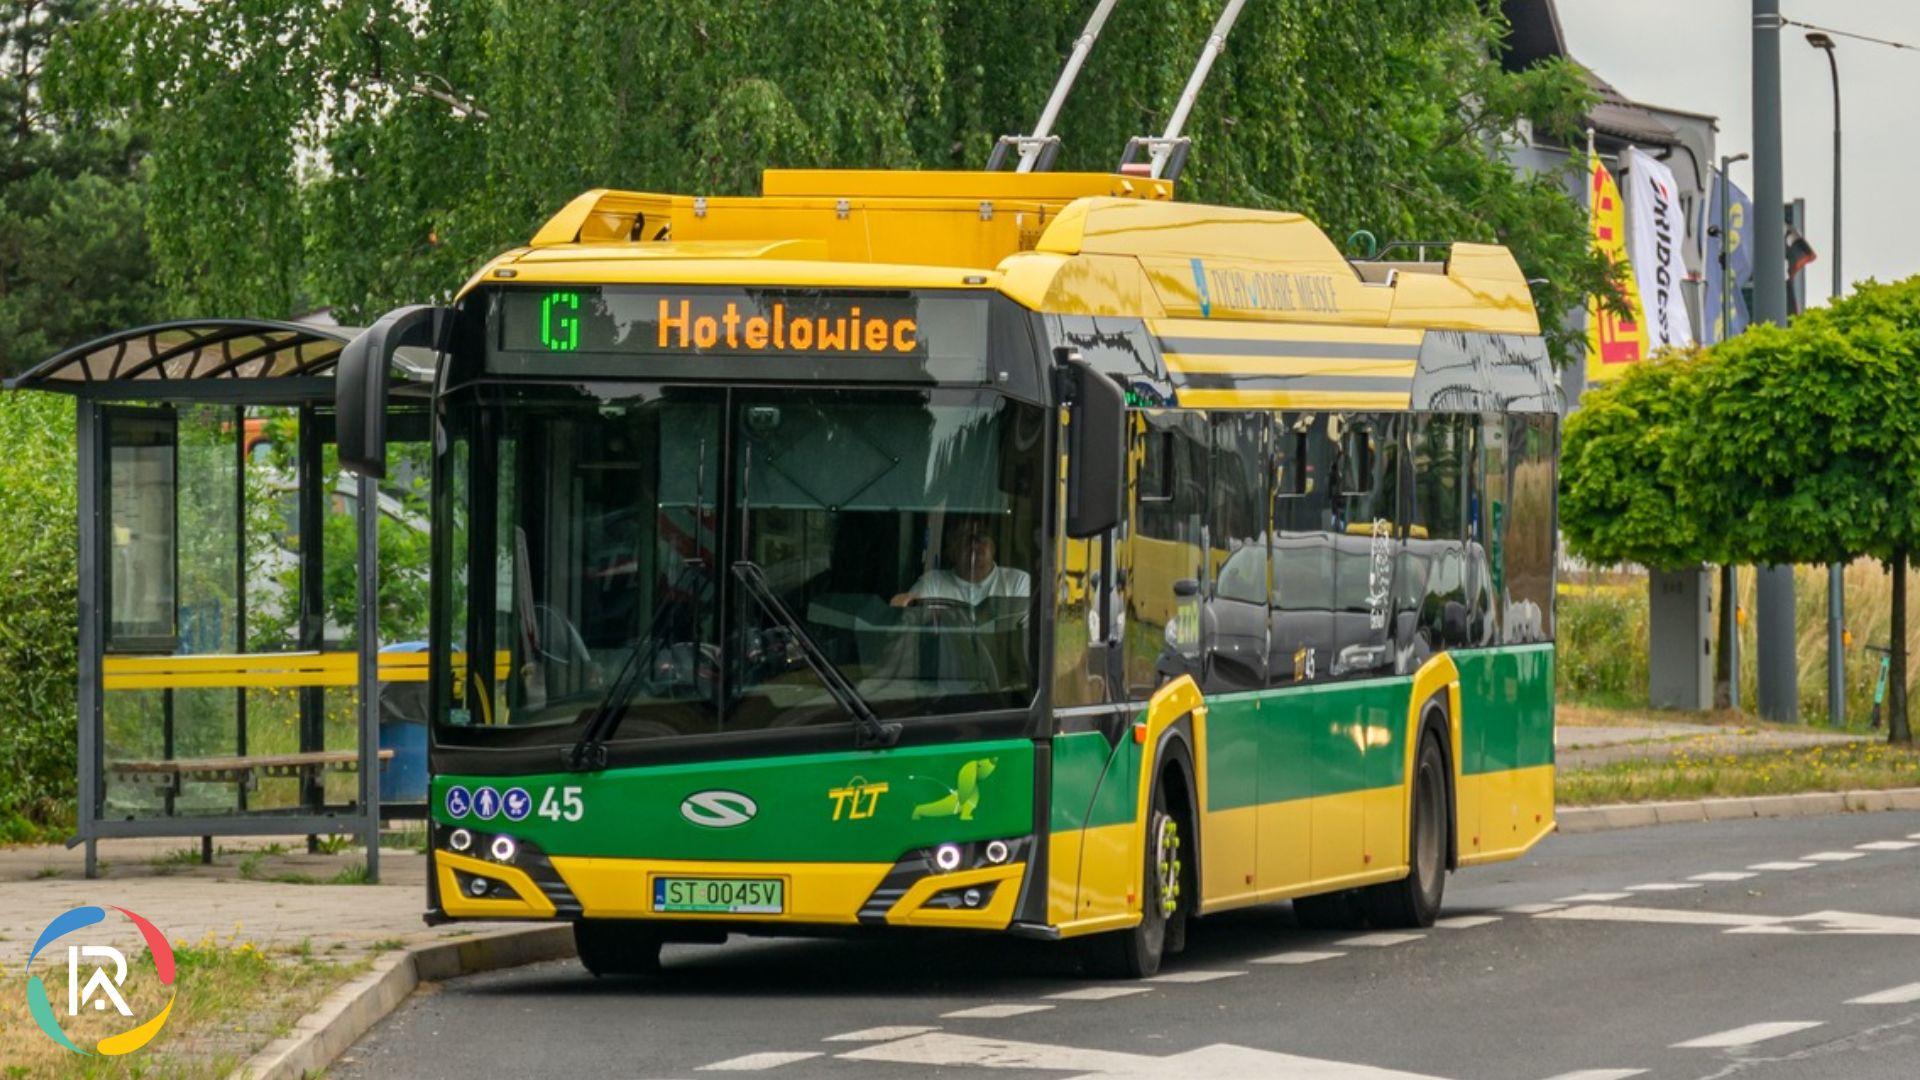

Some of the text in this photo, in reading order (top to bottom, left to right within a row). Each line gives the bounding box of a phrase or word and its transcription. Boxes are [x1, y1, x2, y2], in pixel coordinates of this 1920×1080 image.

[542, 292, 578, 352] G
[659, 299, 917, 352] Hotelowiec
[538, 786, 584, 821] 45
[829, 782, 889, 821] TLT
[670, 882, 698, 904] ST
[707, 883, 776, 905] 0045V
